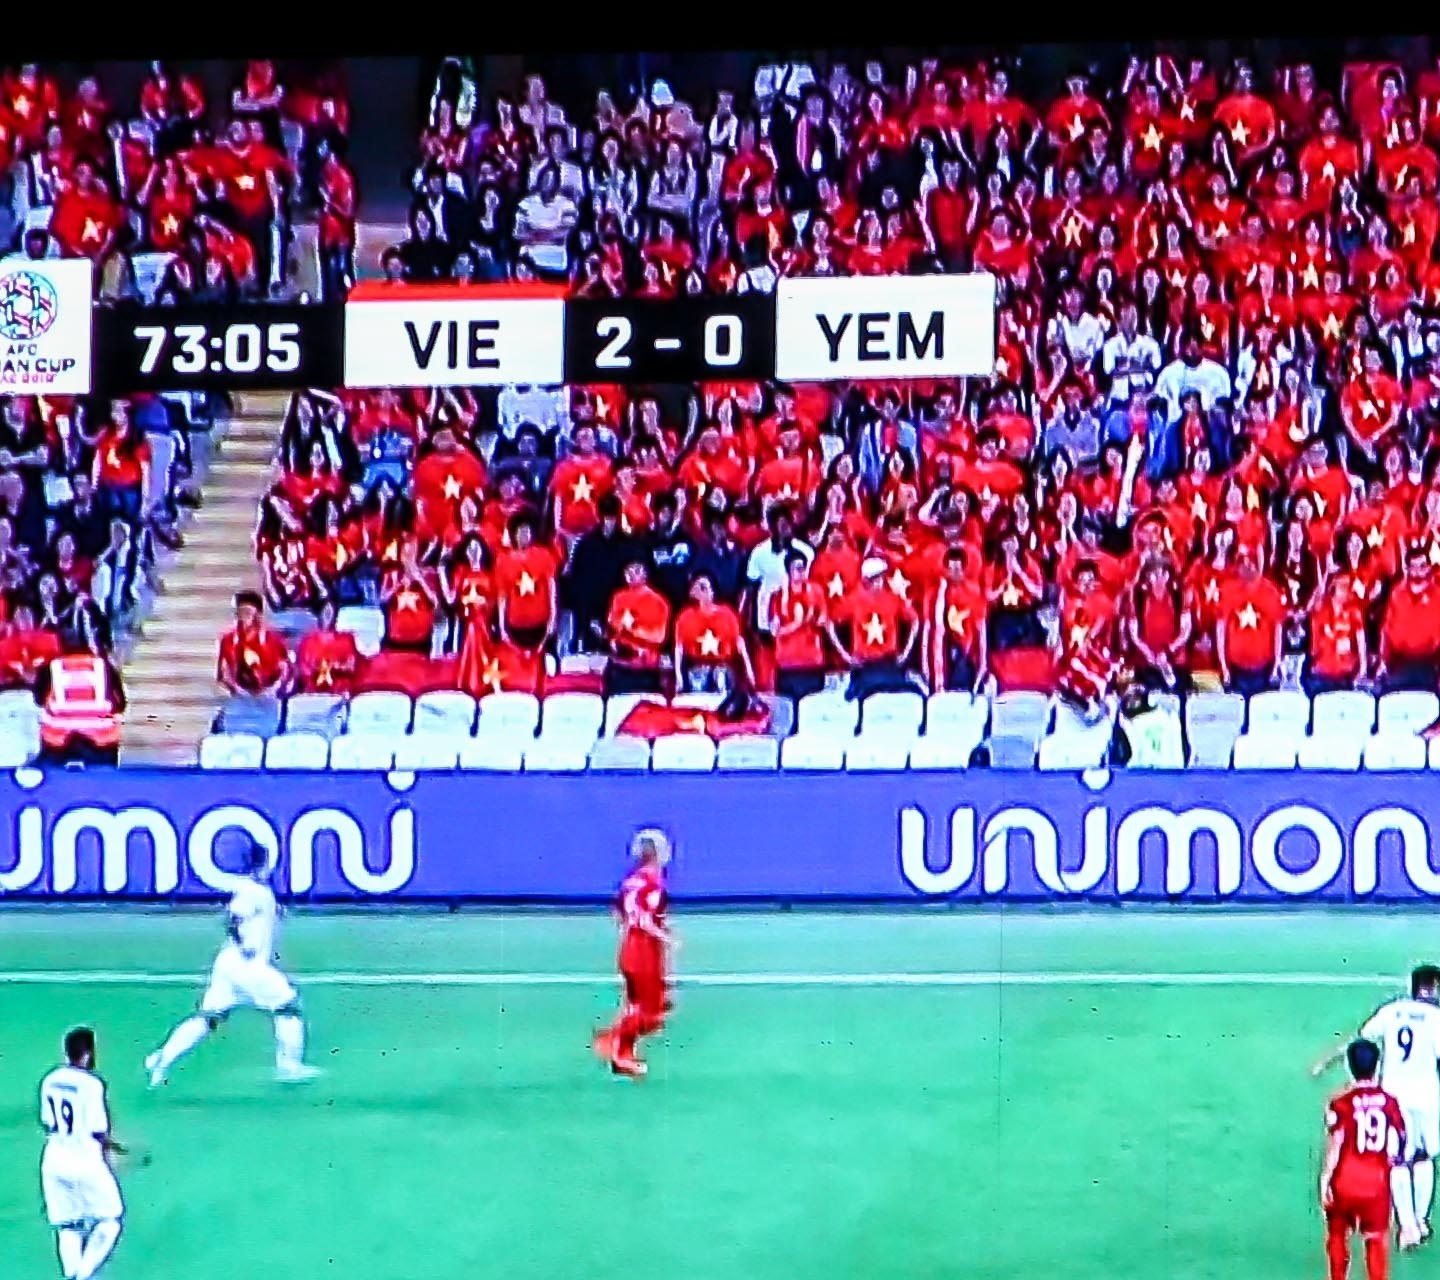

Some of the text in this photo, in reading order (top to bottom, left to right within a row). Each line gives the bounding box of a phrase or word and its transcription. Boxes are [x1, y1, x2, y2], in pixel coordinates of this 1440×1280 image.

[133, 322, 301, 374] 73:05
[403, 319, 501, 370] VIE
[816, 310, 946, 363] YEM
[0, 357, 76, 374] AN CUP
[1397, 1026, 1414, 1062] 9
[1352, 1108, 1387, 1153] 19
